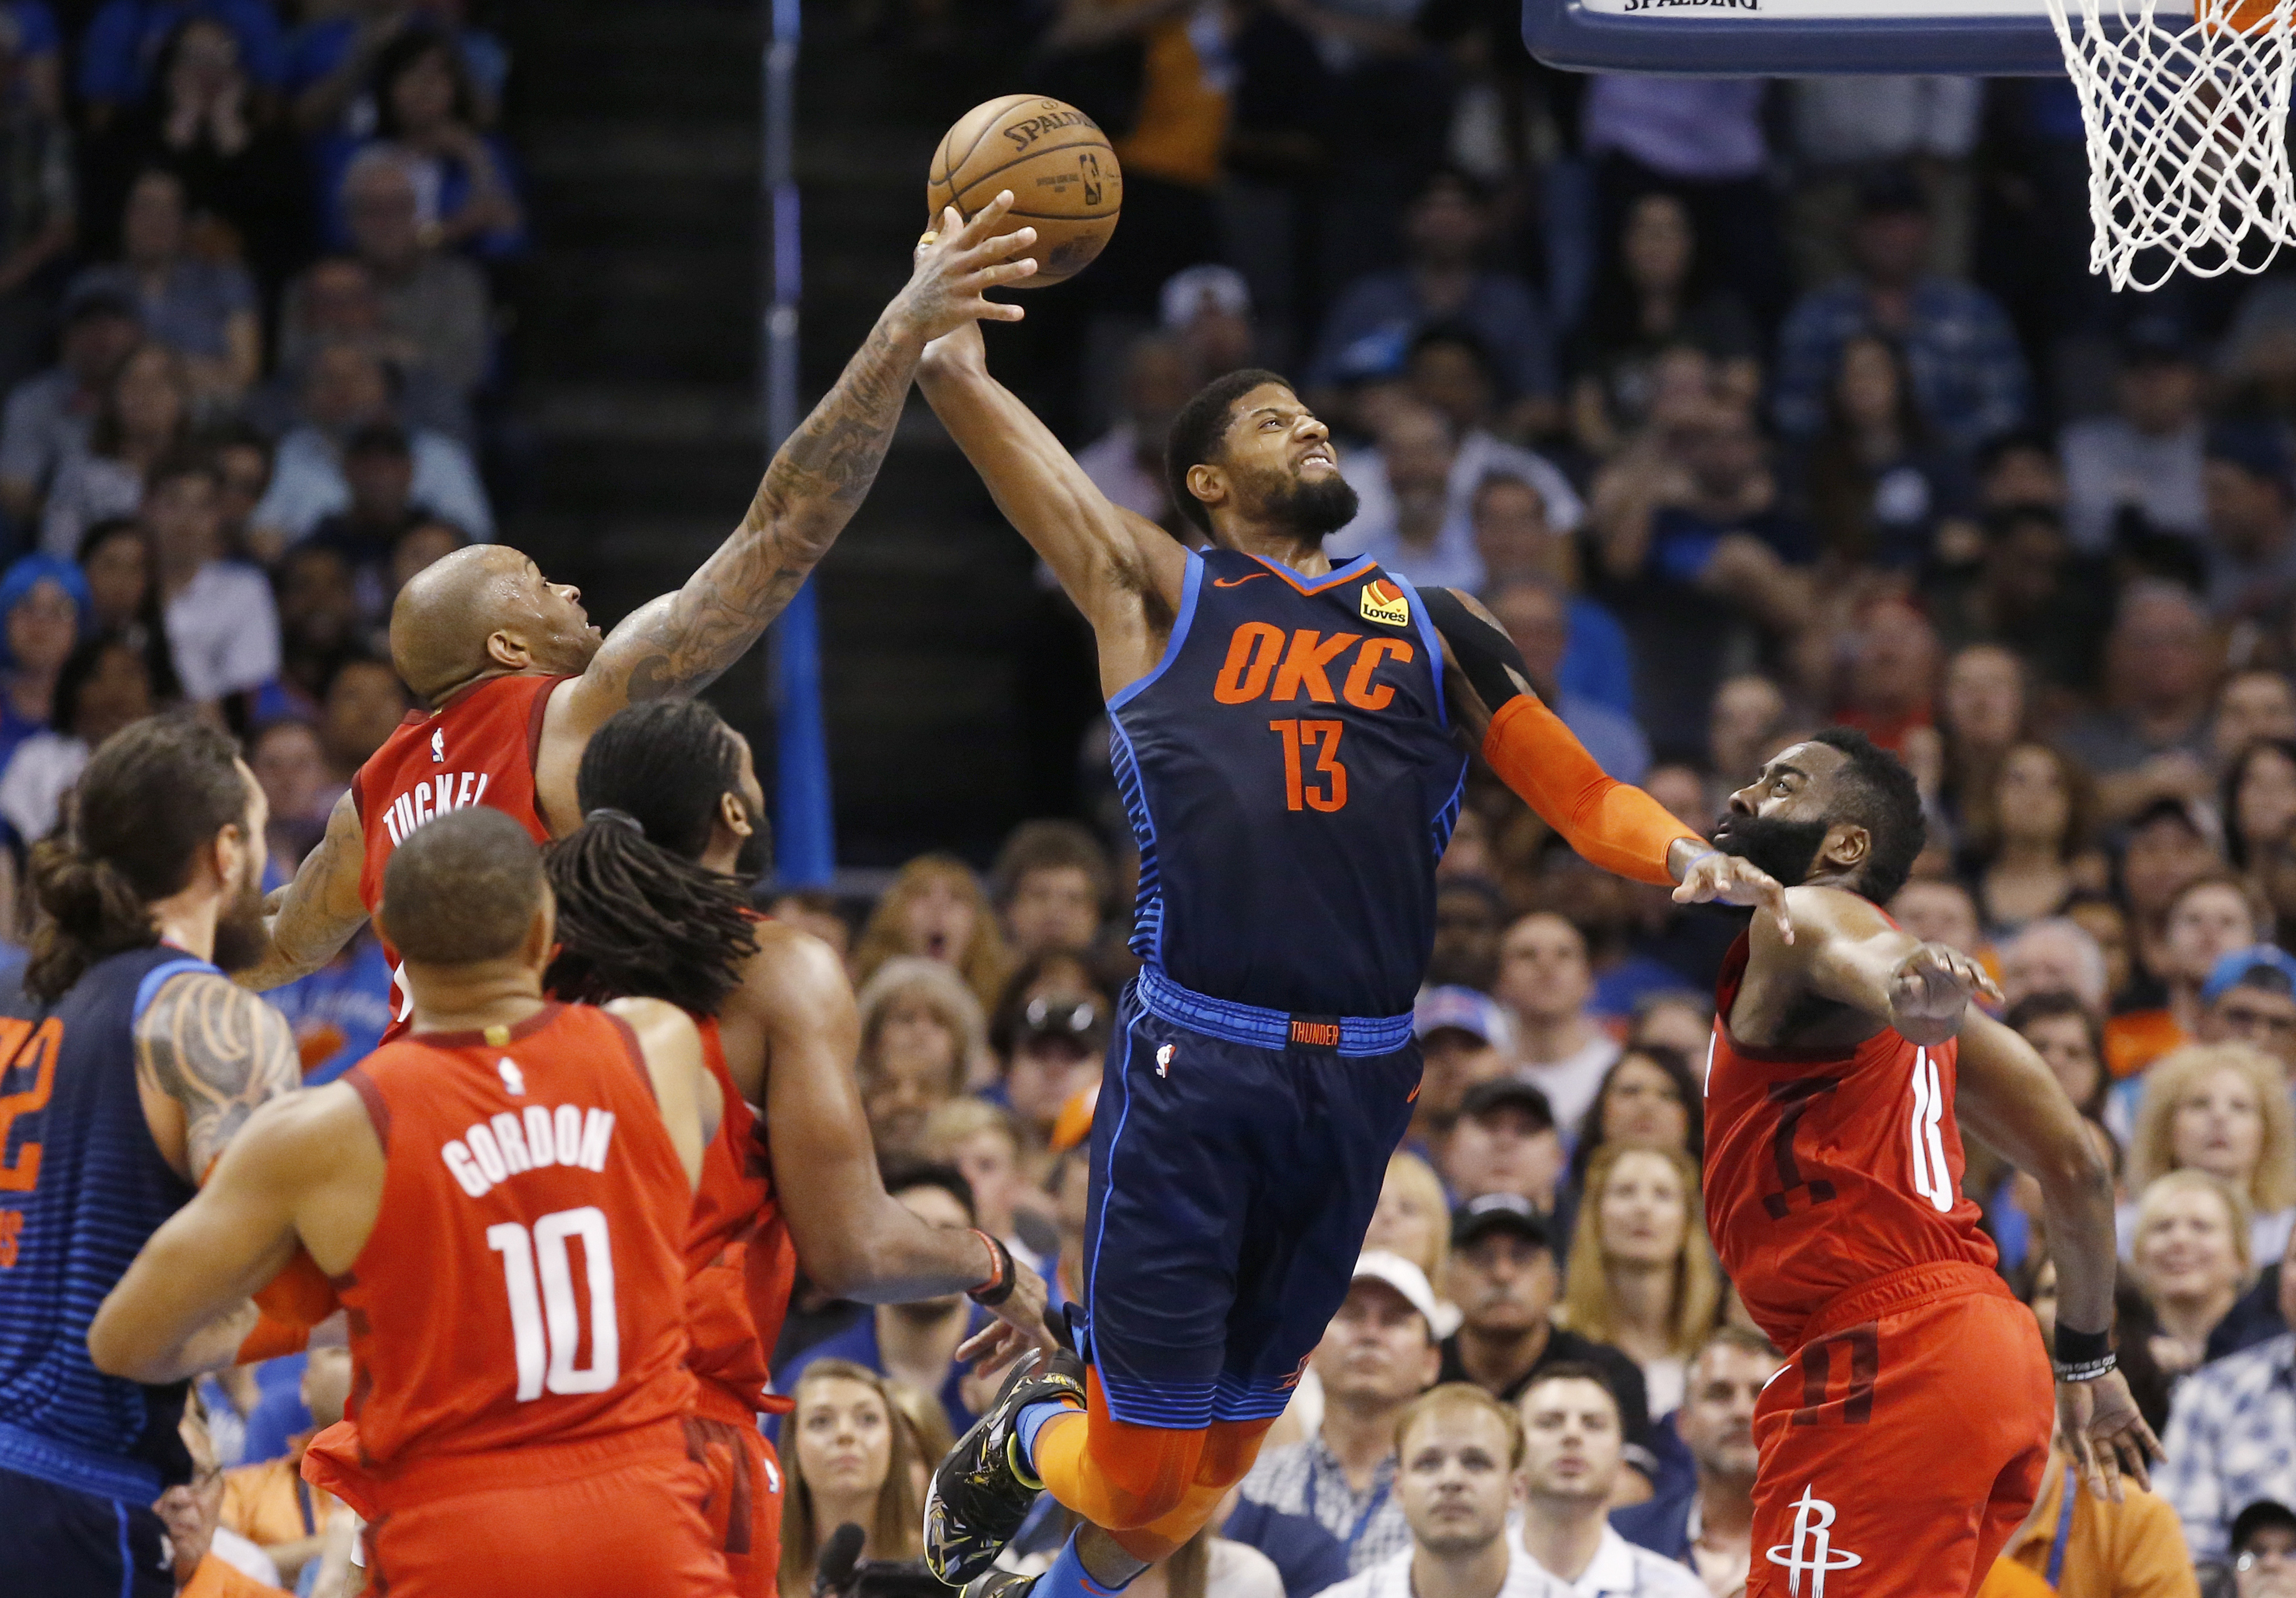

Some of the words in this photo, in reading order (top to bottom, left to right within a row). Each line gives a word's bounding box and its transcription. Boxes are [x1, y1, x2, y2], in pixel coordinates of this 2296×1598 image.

[1004, 112, 1101, 152] SPALD
[1213, 621, 1414, 711] OKC
[1269, 719, 1347, 812] 13
[1291, 1021, 1339, 1046] THUNDER
[441, 1103, 616, 1198] GORDON
[486, 1206, 618, 1403] 10
